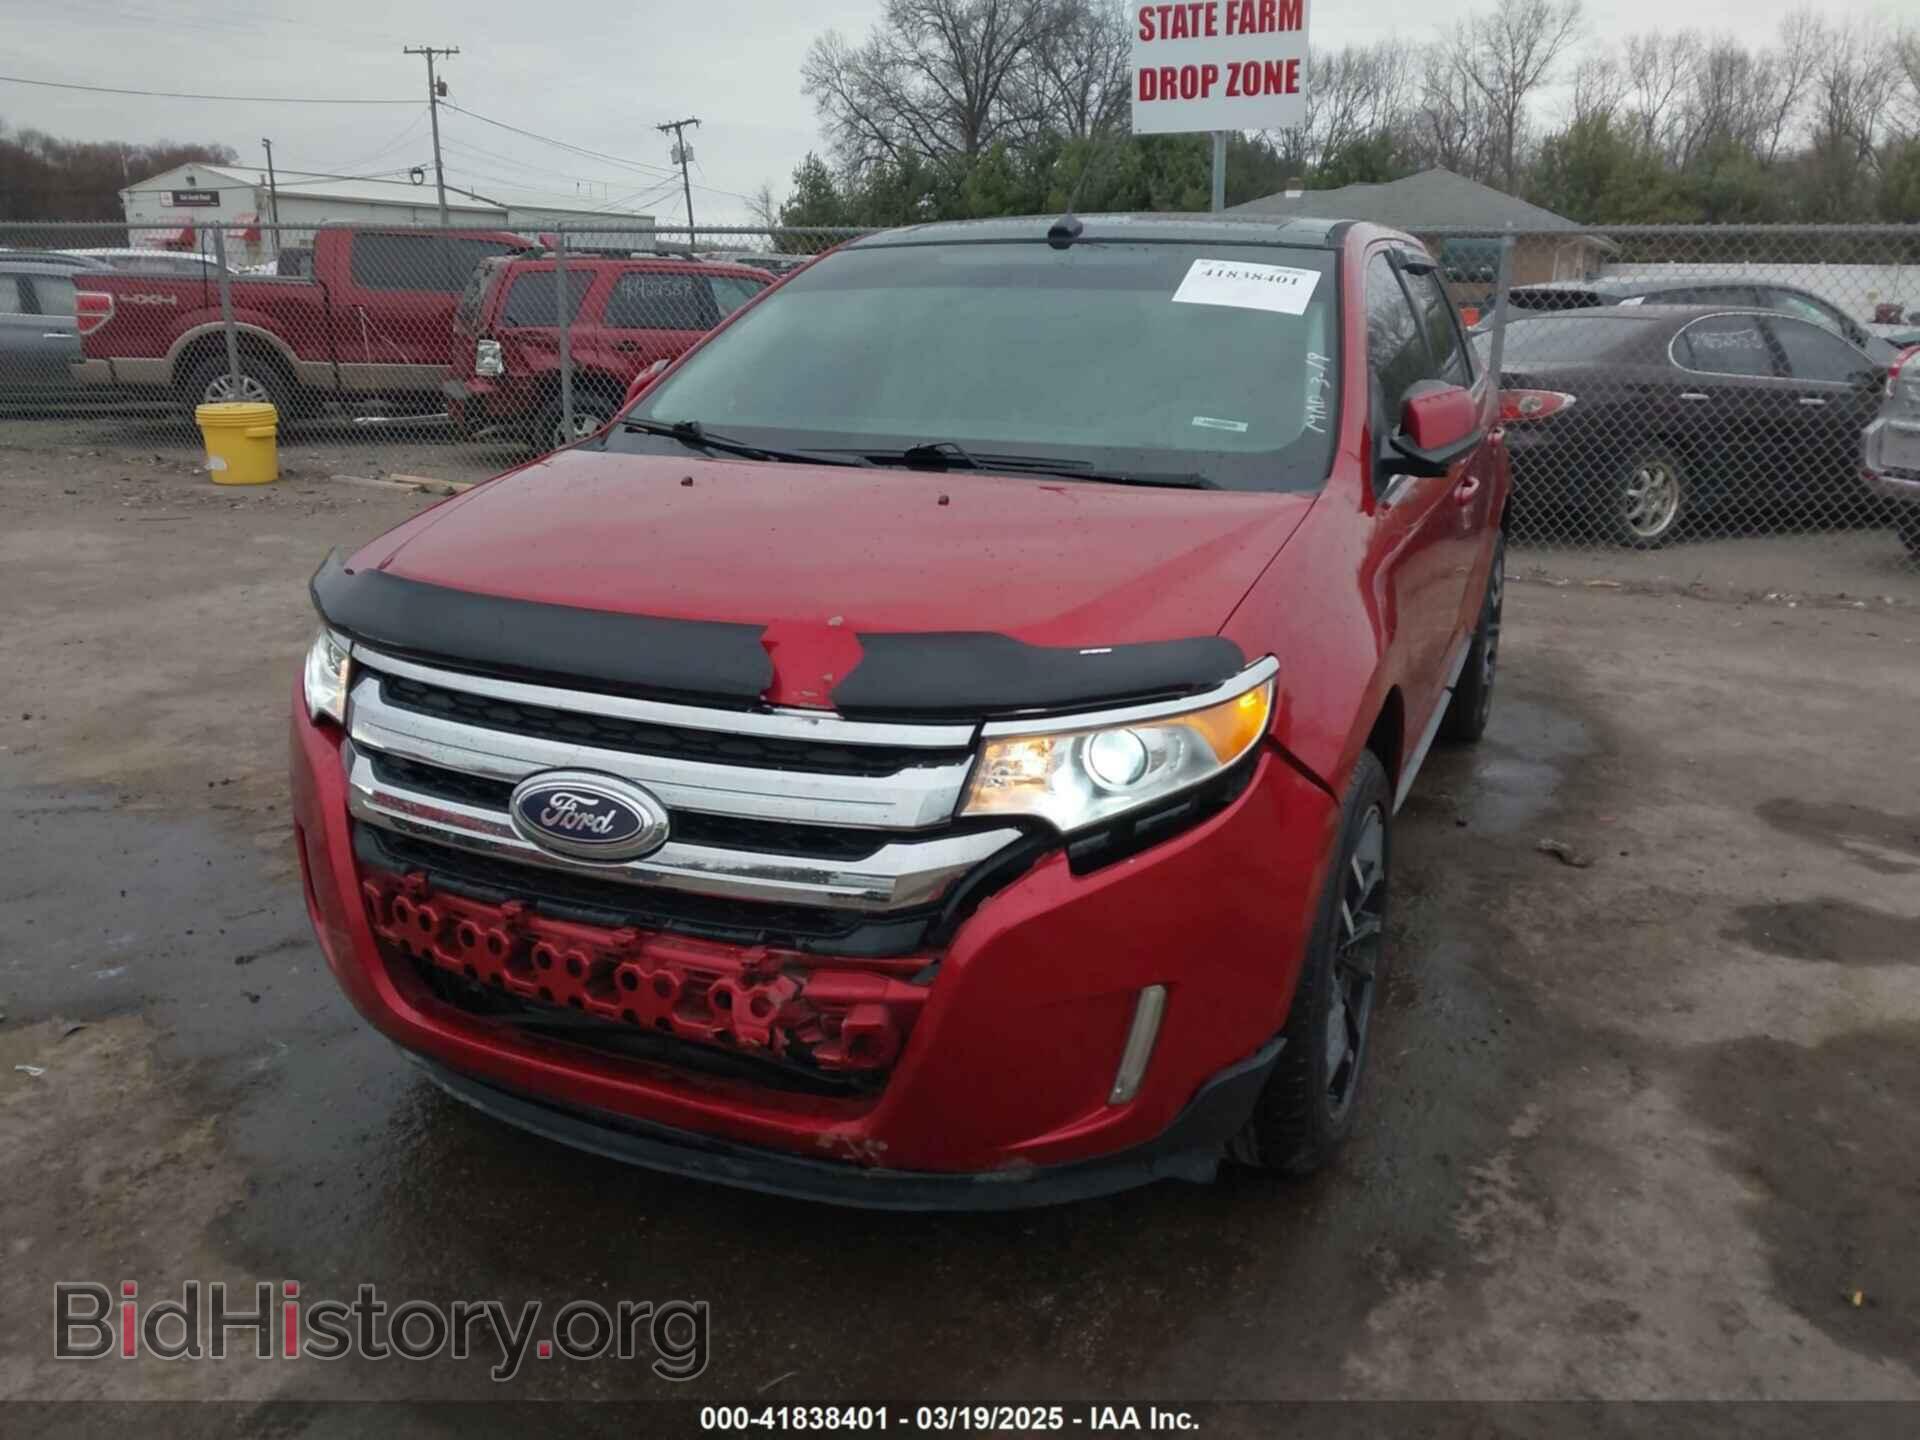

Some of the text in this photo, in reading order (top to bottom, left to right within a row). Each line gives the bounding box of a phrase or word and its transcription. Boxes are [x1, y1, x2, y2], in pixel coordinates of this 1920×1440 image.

[1139, 0, 1303, 41] STATE FARM
[1139, 59, 1300, 101] DROP ZONE
[540, 792, 617, 835] Ford
